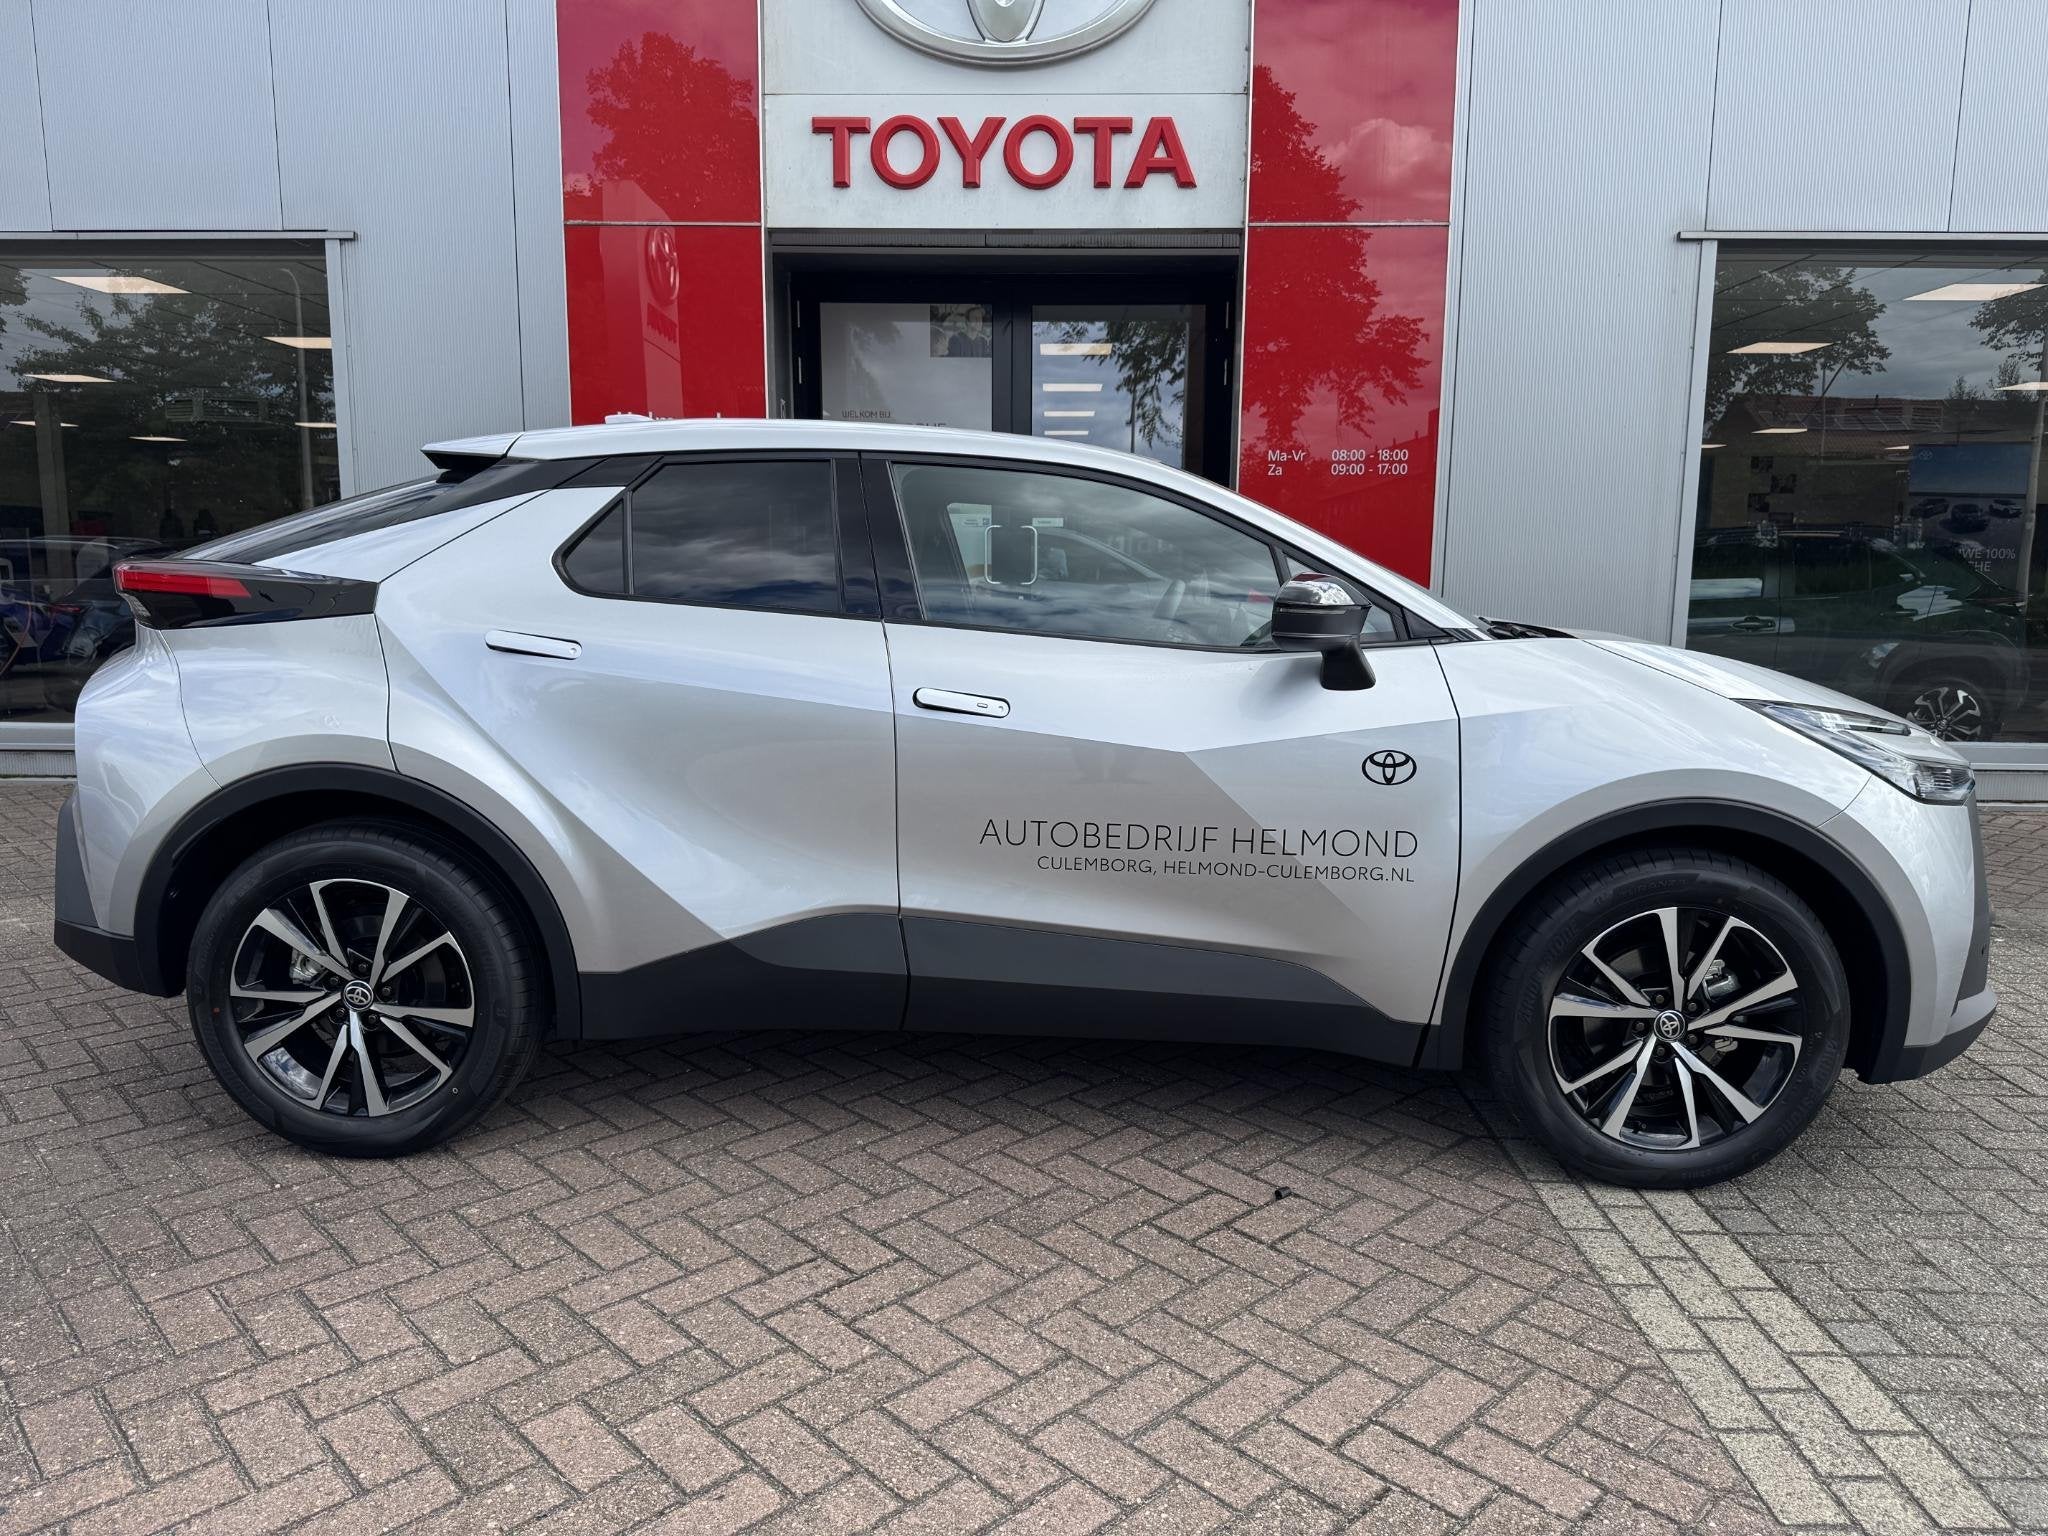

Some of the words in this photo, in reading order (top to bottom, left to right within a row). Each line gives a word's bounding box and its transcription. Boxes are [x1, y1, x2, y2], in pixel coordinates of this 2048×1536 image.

[811, 115, 1197, 190] TOYOTA
[841, 409, 878, 419] WELKOM
[1267, 449, 1306, 462] Ma-Vr
[1331, 449, 1366, 462] 08:00
[1377, 449, 1409, 461] 18:00
[1267, 464, 1283, 476] Za
[1330, 463, 1365, 476] 09:00
[1377, 463, 1408, 475] 17:00
[1986, 547, 2016, 559] 100%
[979, 818, 1219, 853] AUTOBEDRIJF
[1232, 827, 1418, 858] HELMOND
[1037, 855, 1157, 876] CULEMBORG,
[1163, 860, 1415, 883] HELMOND-CULEMBORG.NL
